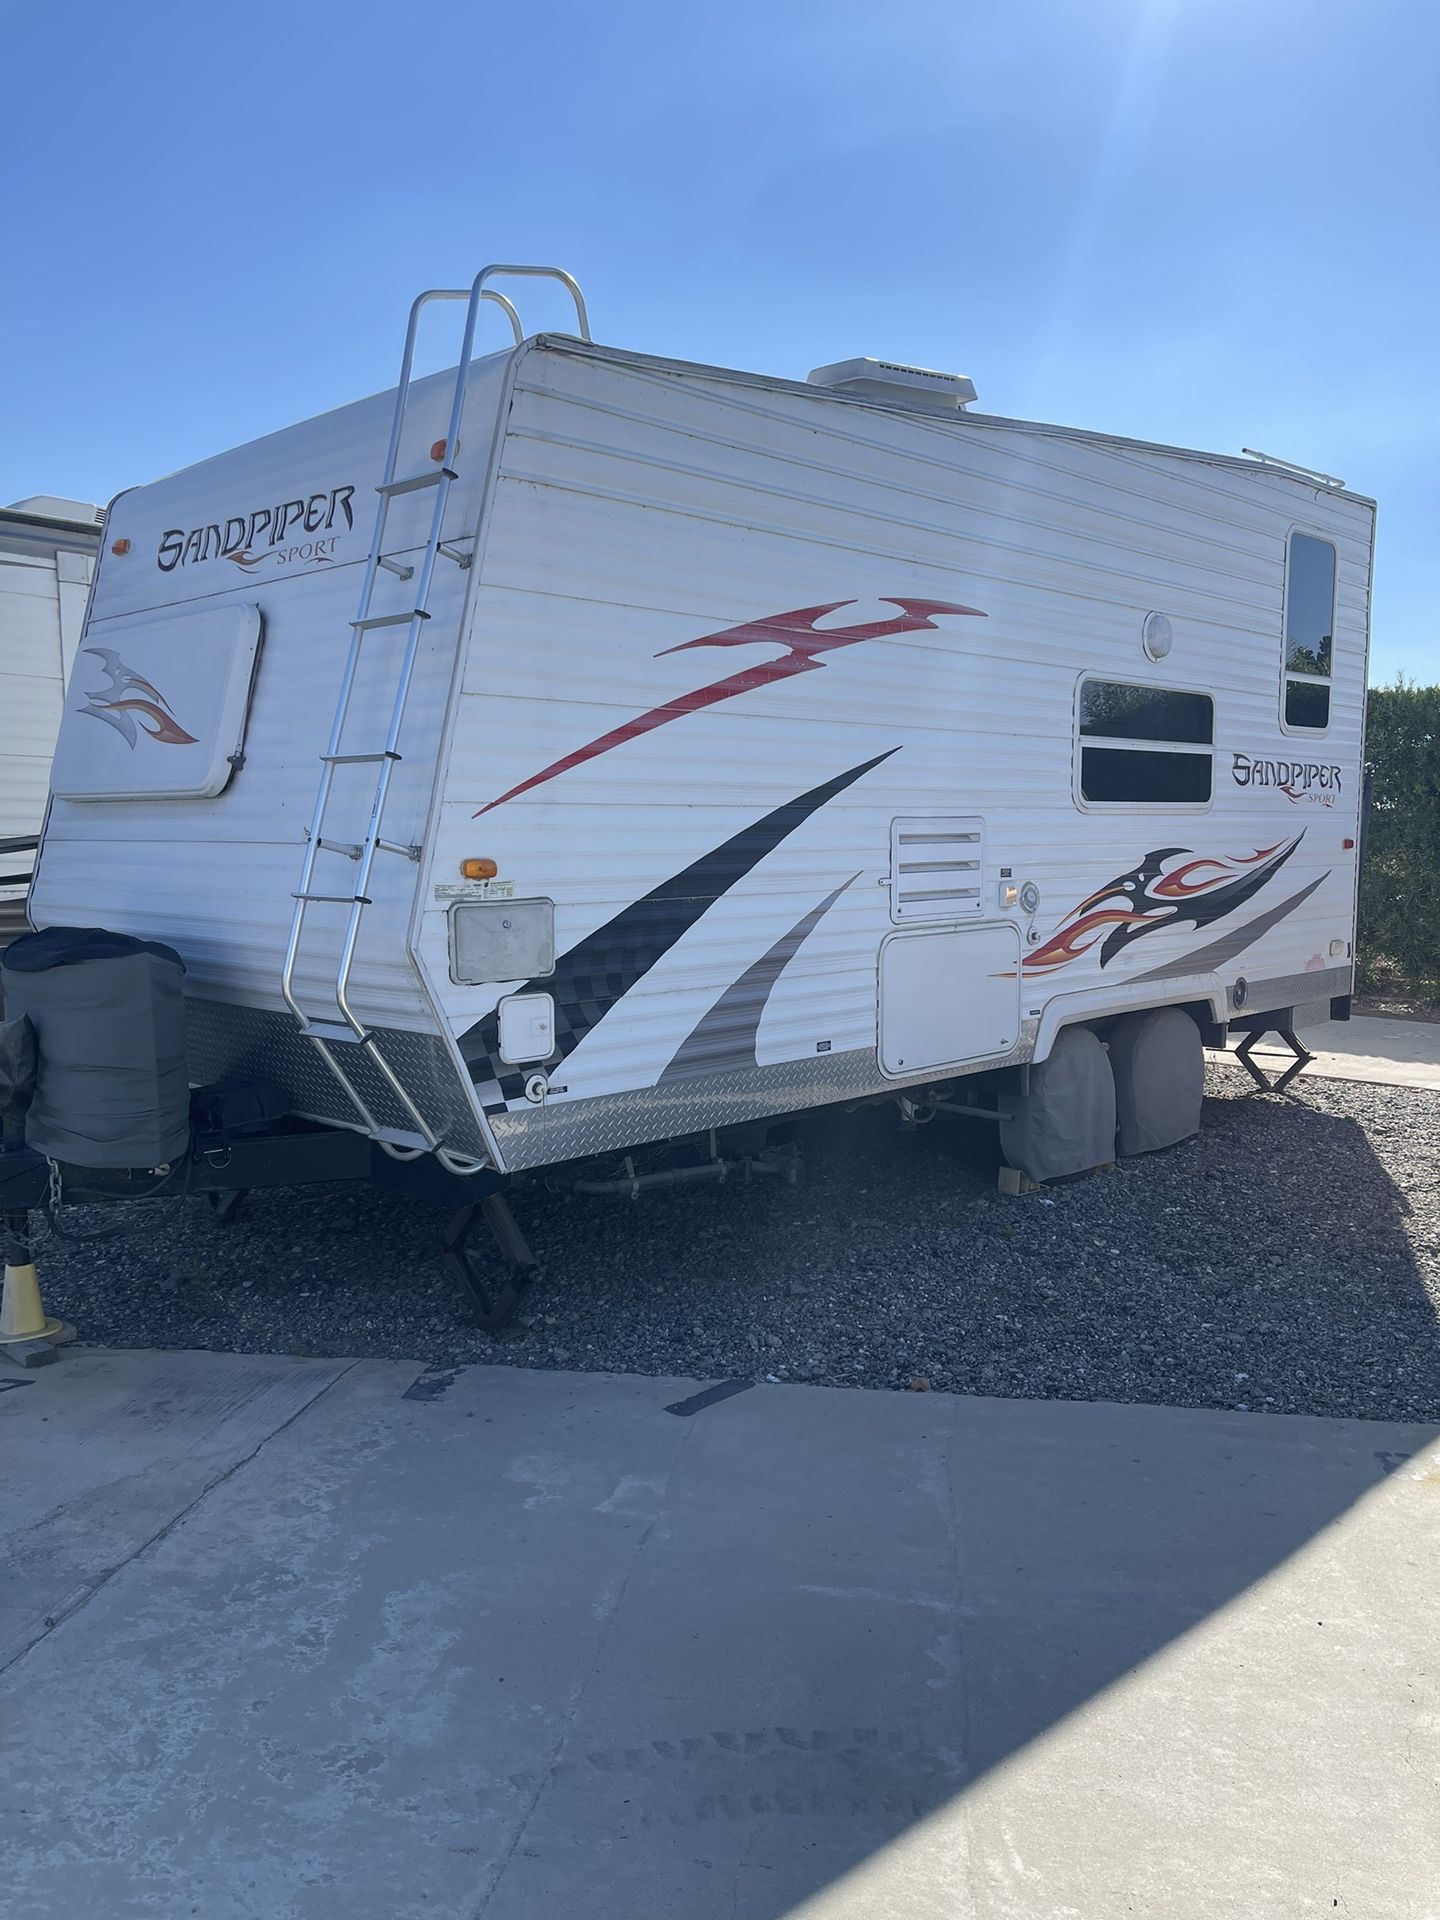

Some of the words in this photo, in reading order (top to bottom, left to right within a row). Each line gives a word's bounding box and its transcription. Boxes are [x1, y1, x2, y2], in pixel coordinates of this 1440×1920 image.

[157, 485, 355, 572] SANDPIPER
[277, 536, 341, 565] SPORT
[1232, 753, 1342, 794] SANDPIPER
[1308, 793, 1336, 804] SPORT
